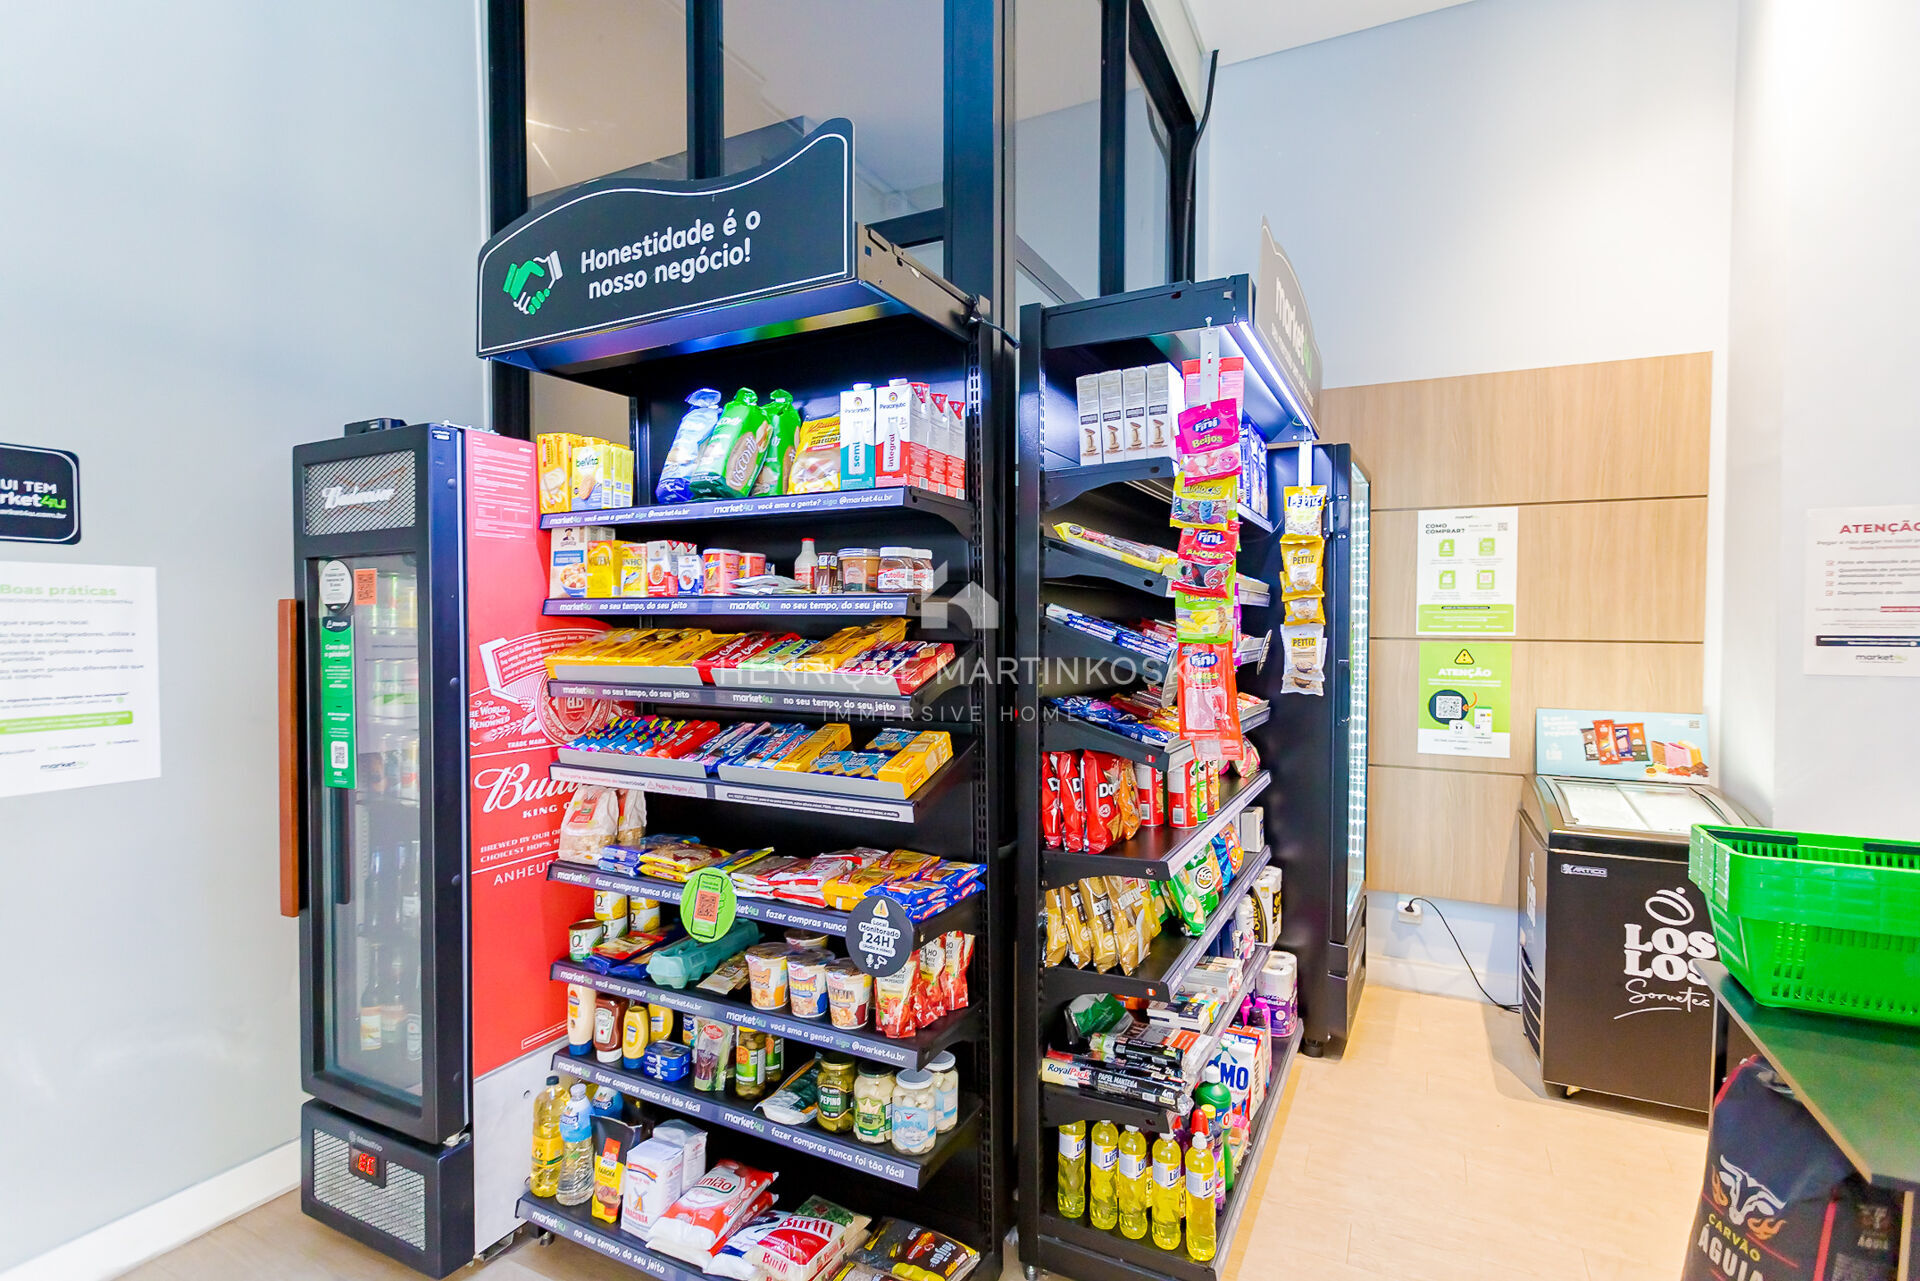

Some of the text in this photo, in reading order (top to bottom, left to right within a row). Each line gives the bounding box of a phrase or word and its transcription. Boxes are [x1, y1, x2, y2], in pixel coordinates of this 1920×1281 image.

[581, 209, 761, 274] Honestidade é o
[588, 238, 751, 300] nosso negócio!
[1194, 417, 1219, 432] Fini
[1192, 434, 1222, 448] Beijos
[852, 441, 861, 467] semi
[887, 433, 897, 468] integral
[0, 479, 57, 494] UI TEM
[0, 492, 66, 509] rket4u
[713, 503, 753, 513] market4u
[796, 499, 820, 508] gente?
[838, 493, 892, 505] @market4u.br
[1198, 531, 1223, 545] Fini
[1292, 555, 1314, 564] PETTIZ
[48, 584, 117, 597] práticas
[729, 602, 769, 610] market4u
[809, 602, 838, 610] tempo,
[840, 601, 852, 609] do
[871, 601, 893, 611] jeito
[1292, 638, 1315, 647] PETTIZ
[1438, 667, 1492, 678] ATENÇÃO
[624, 688, 648, 698] tempo,
[672, 690, 689, 700] jeito
[732, 693, 772, 703] market4u
[811, 698, 842, 710] tempo,
[843, 699, 855, 708] do
[874, 701, 896, 713] jeito
[508, 740, 527, 748] TRADE
[522, 804, 558, 819] KING
[480, 839, 518, 853] BREWED
[532, 832, 550, 841] OUR
[480, 848, 524, 862] CHOICEST
[494, 860, 553, 886] ANHEU
[765, 908, 786, 921] fazer
[787, 913, 821, 928] compras
[823, 921, 847, 932] nunca
[873, 920, 887, 928] Local
[860, 923, 900, 938] Monitorado
[866, 933, 891, 947] 24H
[1624, 923, 1717, 959] LOS
[1625, 978, 1710, 1012] Sorvetes
[725, 1010, 766, 1028] market4u
[770, 1021, 785, 1032] você
[786, 1027, 802, 1036] ama
[810, 1031, 833, 1044] gente?
[851, 1041, 905, 1062] @market4u.br
[1047, 1063, 1091, 1081] RoyalPack
[1097, 1072, 1114, 1083] PAPEL
[1207, 1060, 1249, 1090] MO
[595, 1071, 611, 1084] fazer
[612, 1078, 639, 1094] compras
[671, 1095, 683, 1107] tão
[684, 1099, 700, 1113] fácil
[820, 1095, 841, 1106] PEPINO
[723, 1111, 904, 1179] market4u fazer compras nunca foi tão fácil
[698, 1176, 731, 1191] união
[531, 1210, 566, 1232] market4u
[583, 1233, 596, 1244] seu
[597, 1238, 622, 1256] tempo,
[633, 1252, 645, 1264] seu
[647, 1258, 664, 1274] jeito
[1708, 1213, 1761, 1262] CARVÃO
[930, 1240, 957, 1268] Feijão
[1698, 1223, 1764, 1281] ÁGUIA
